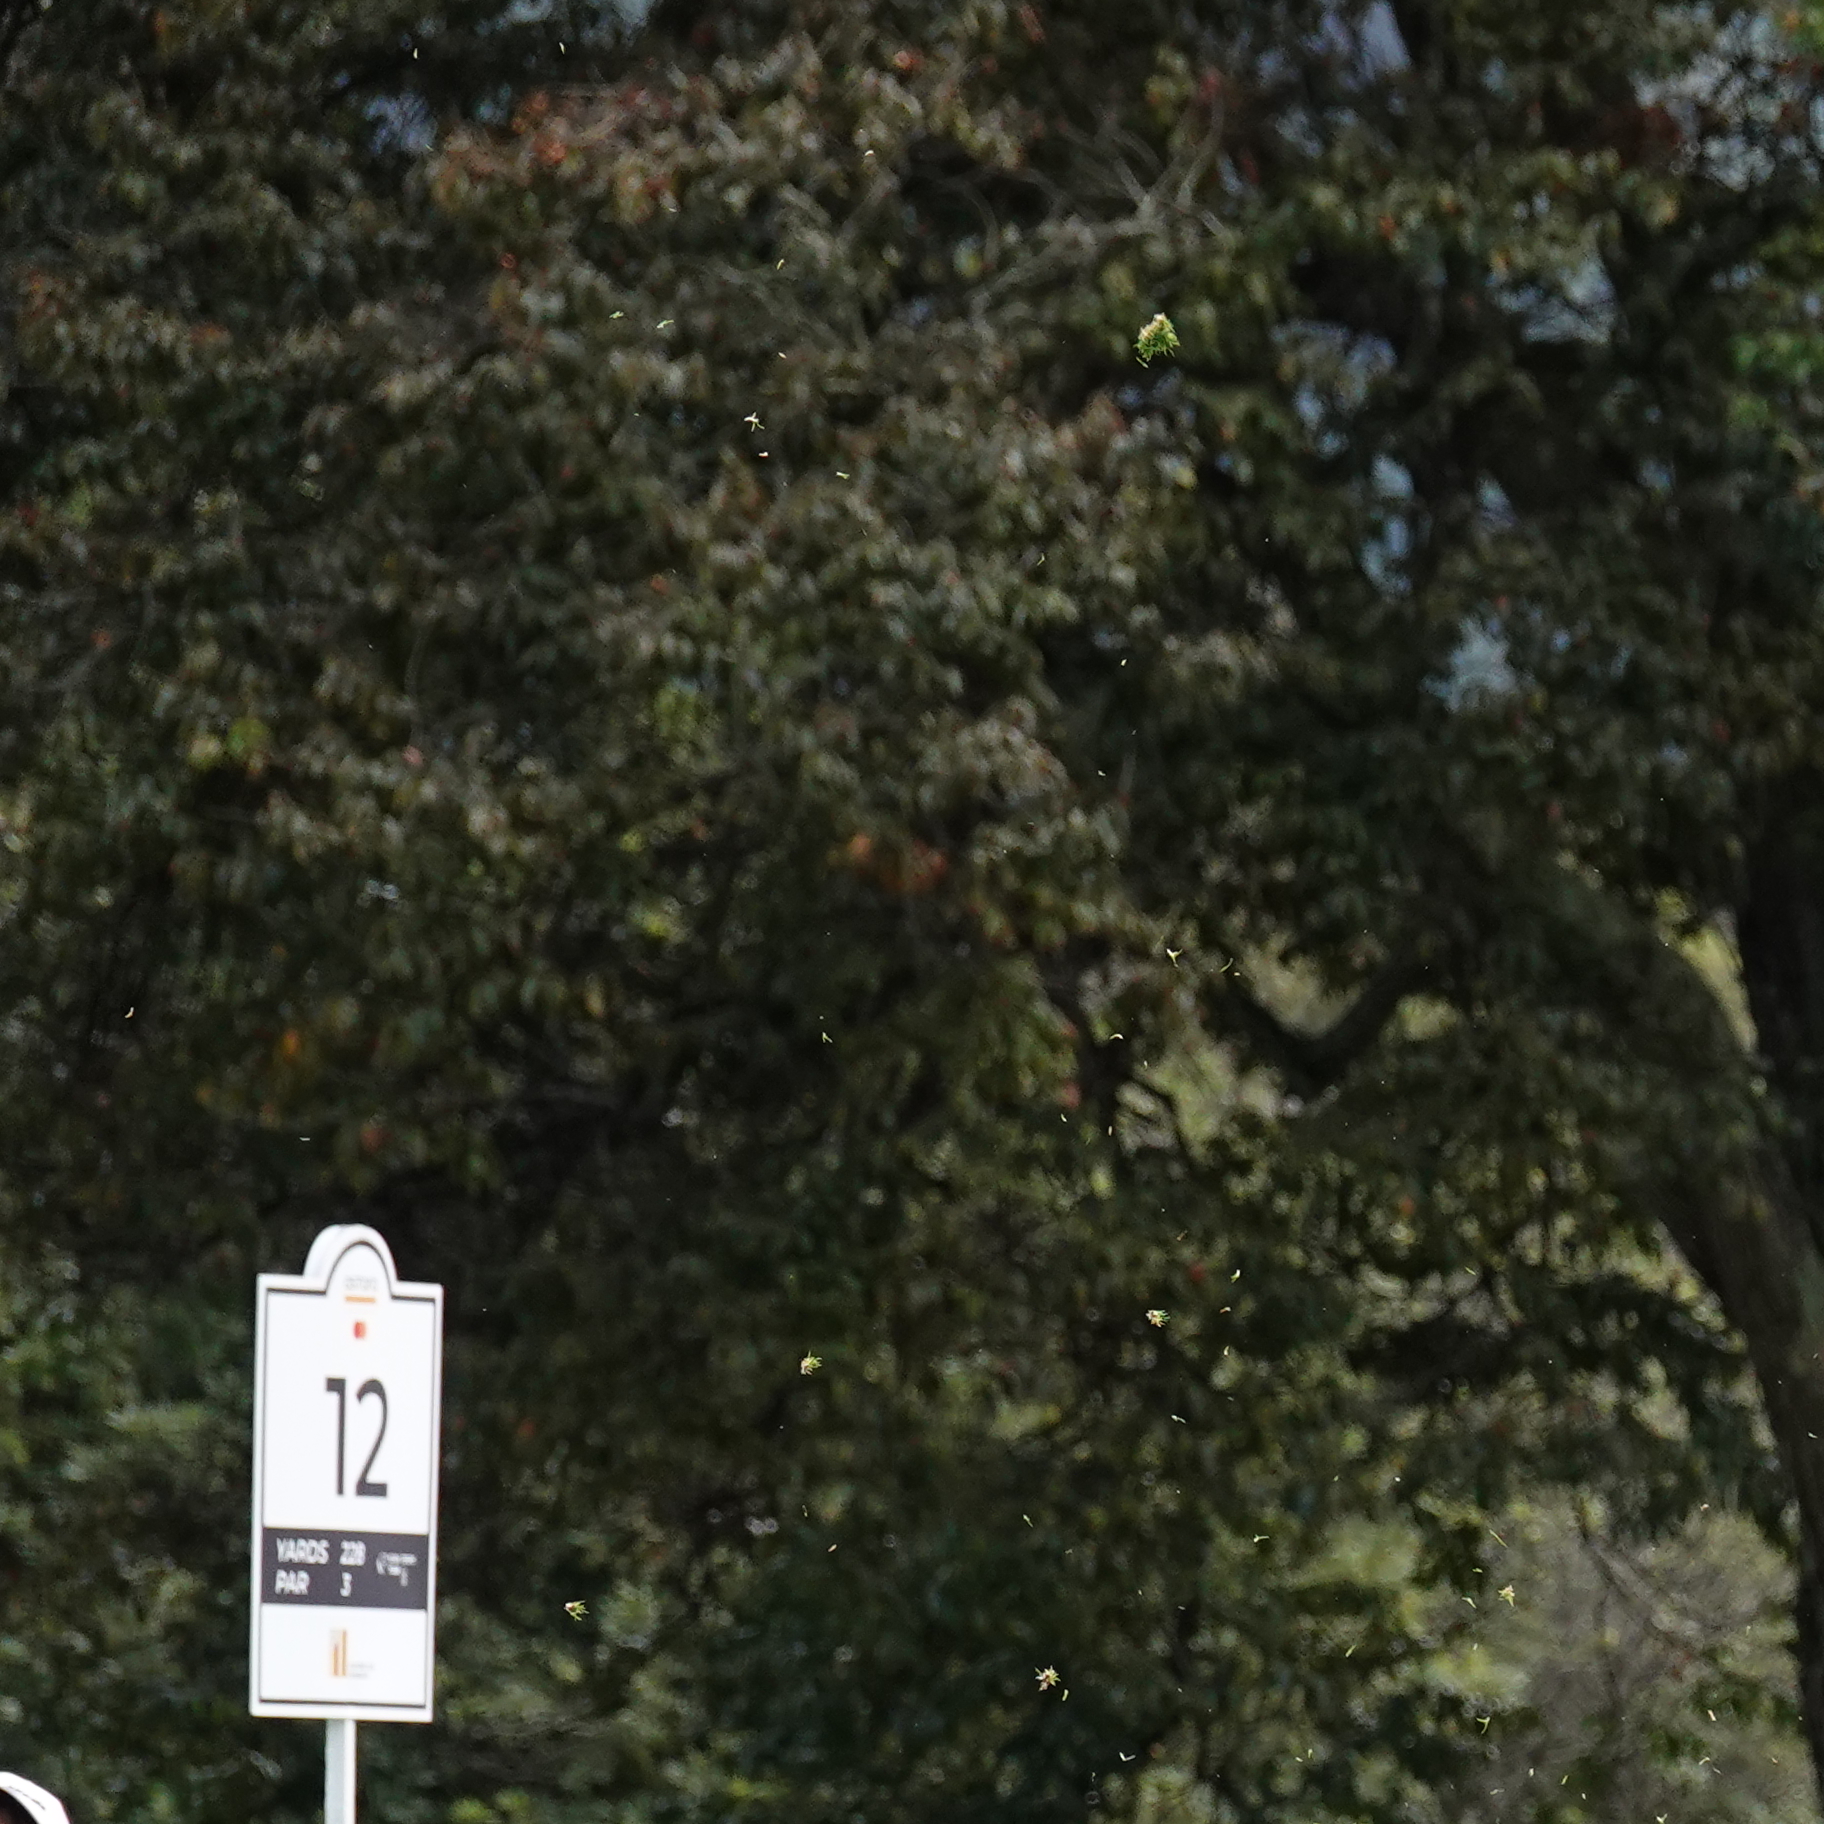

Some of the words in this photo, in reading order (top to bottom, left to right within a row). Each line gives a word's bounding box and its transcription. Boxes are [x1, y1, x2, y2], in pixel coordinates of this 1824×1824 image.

[325, 1377, 389, 1498] 12
[276, 1537, 330, 1565] YARDS
[274, 1568, 310, 1596] PAR
[340, 1571, 353, 1598] 3
